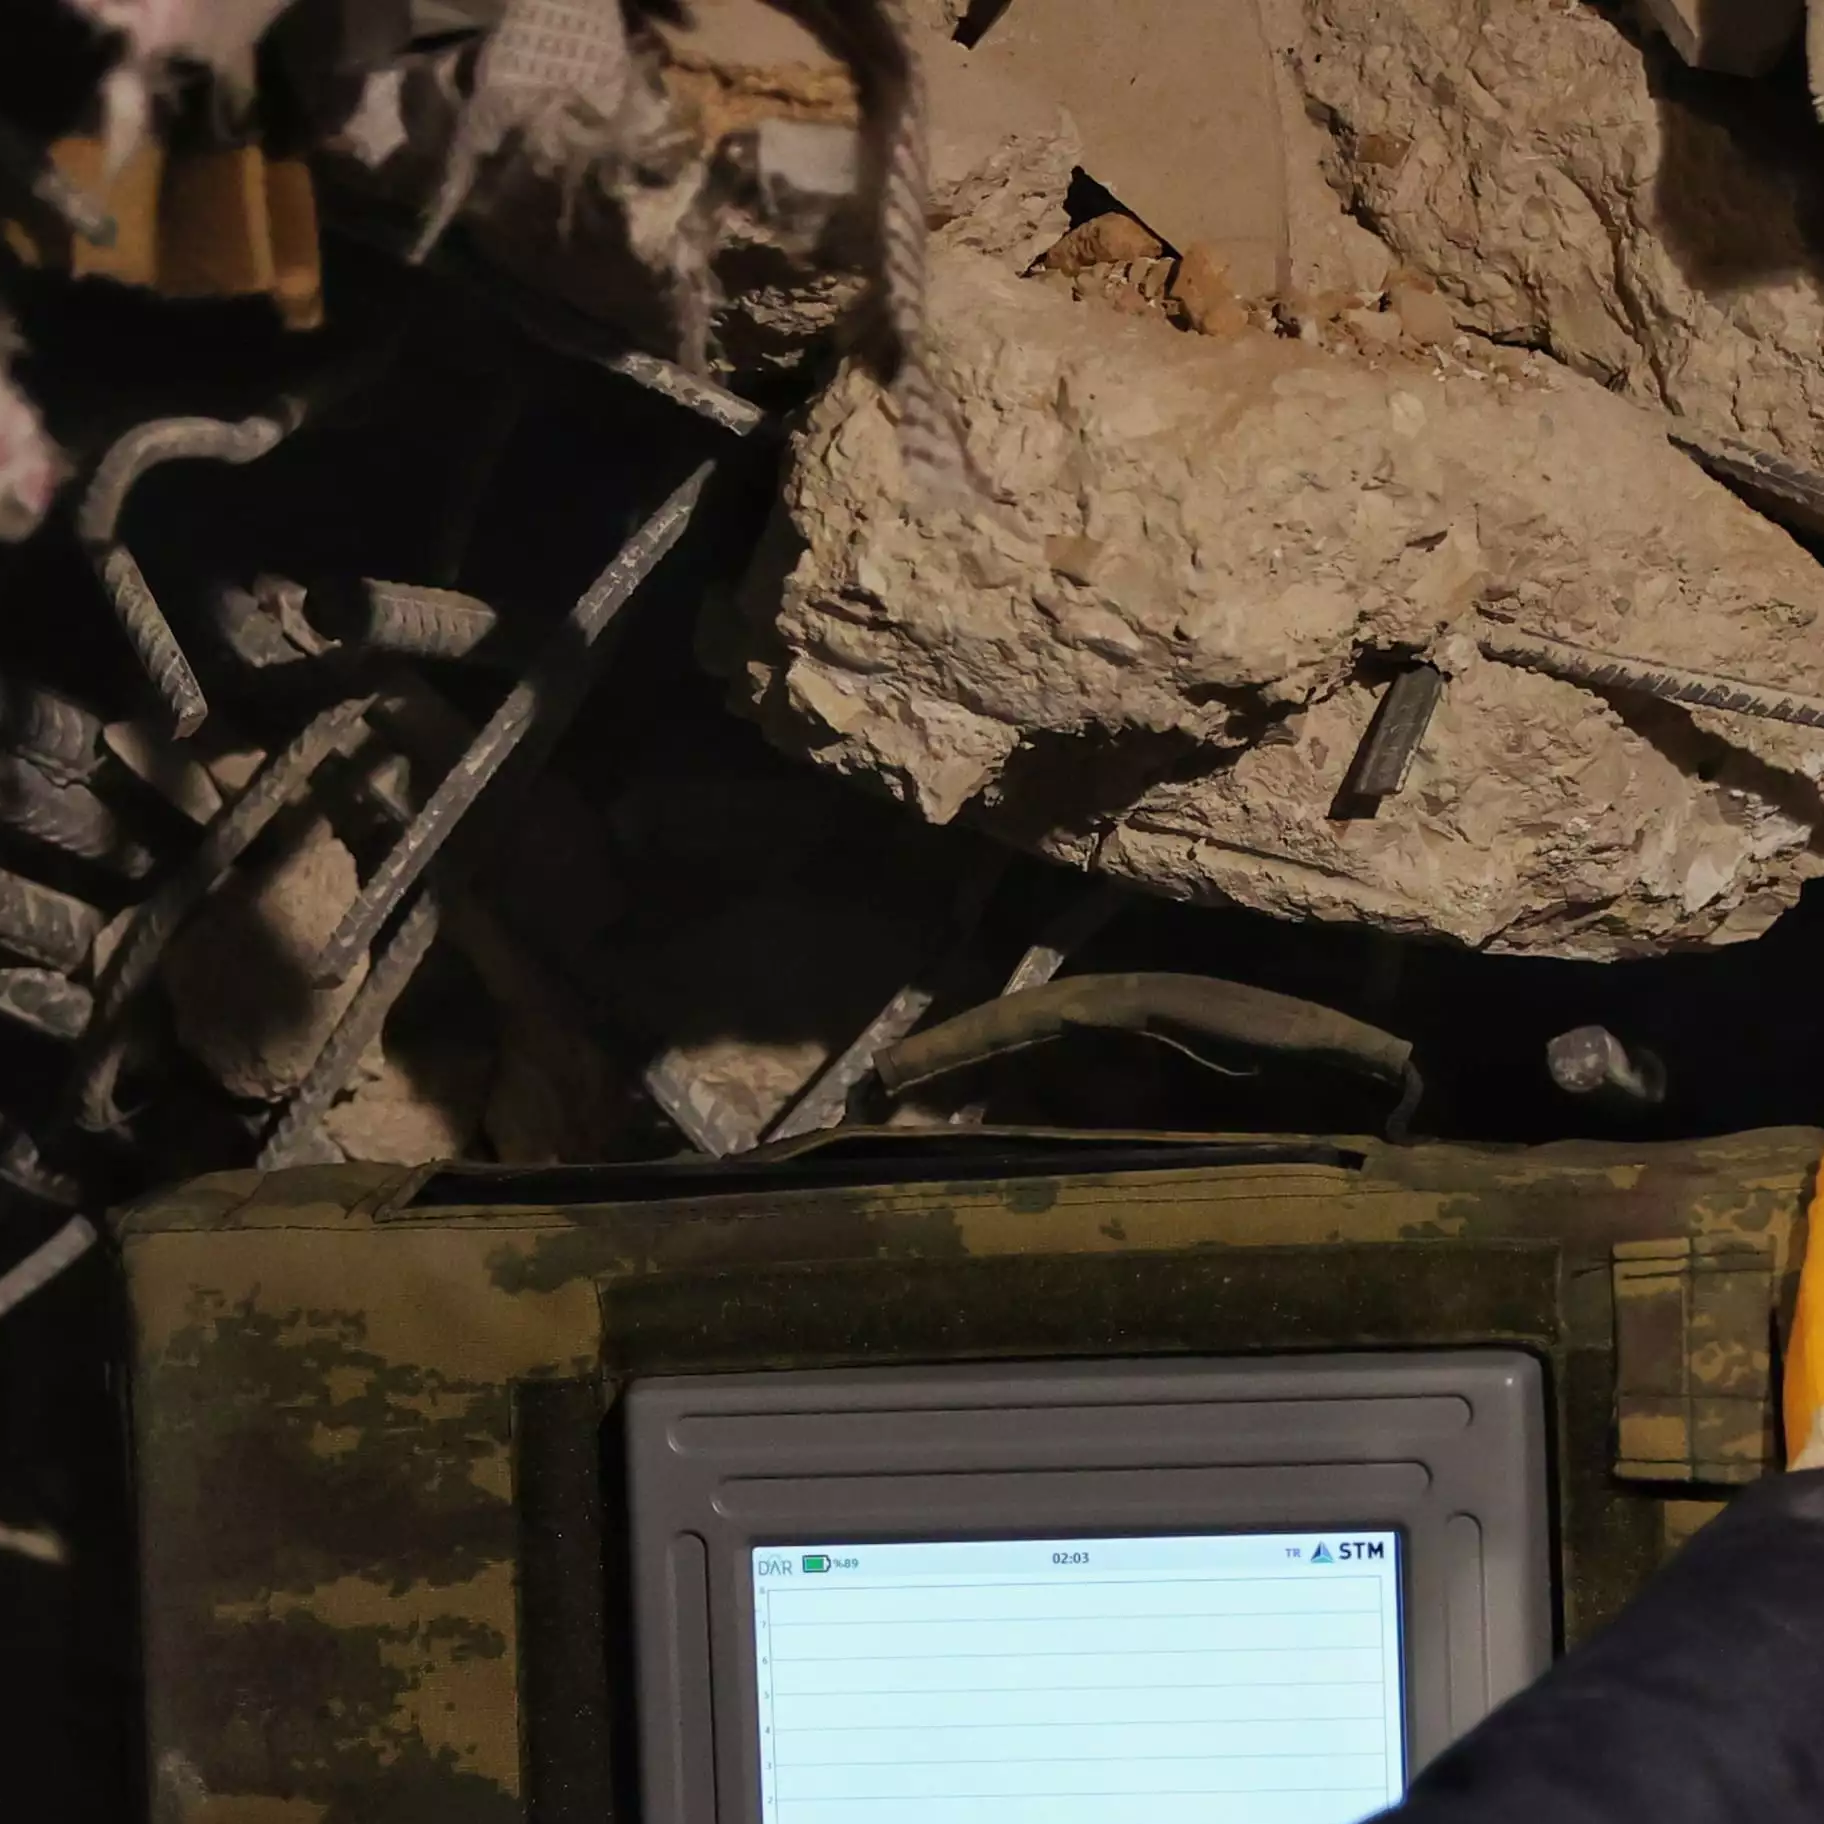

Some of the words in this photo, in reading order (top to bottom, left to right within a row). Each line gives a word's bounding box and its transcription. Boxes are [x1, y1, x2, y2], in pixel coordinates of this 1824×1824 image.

[1284, 1548, 1301, 1558] TR
[1339, 1541, 1384, 1560] STM
[1052, 1552, 1090, 1564] 02:03
